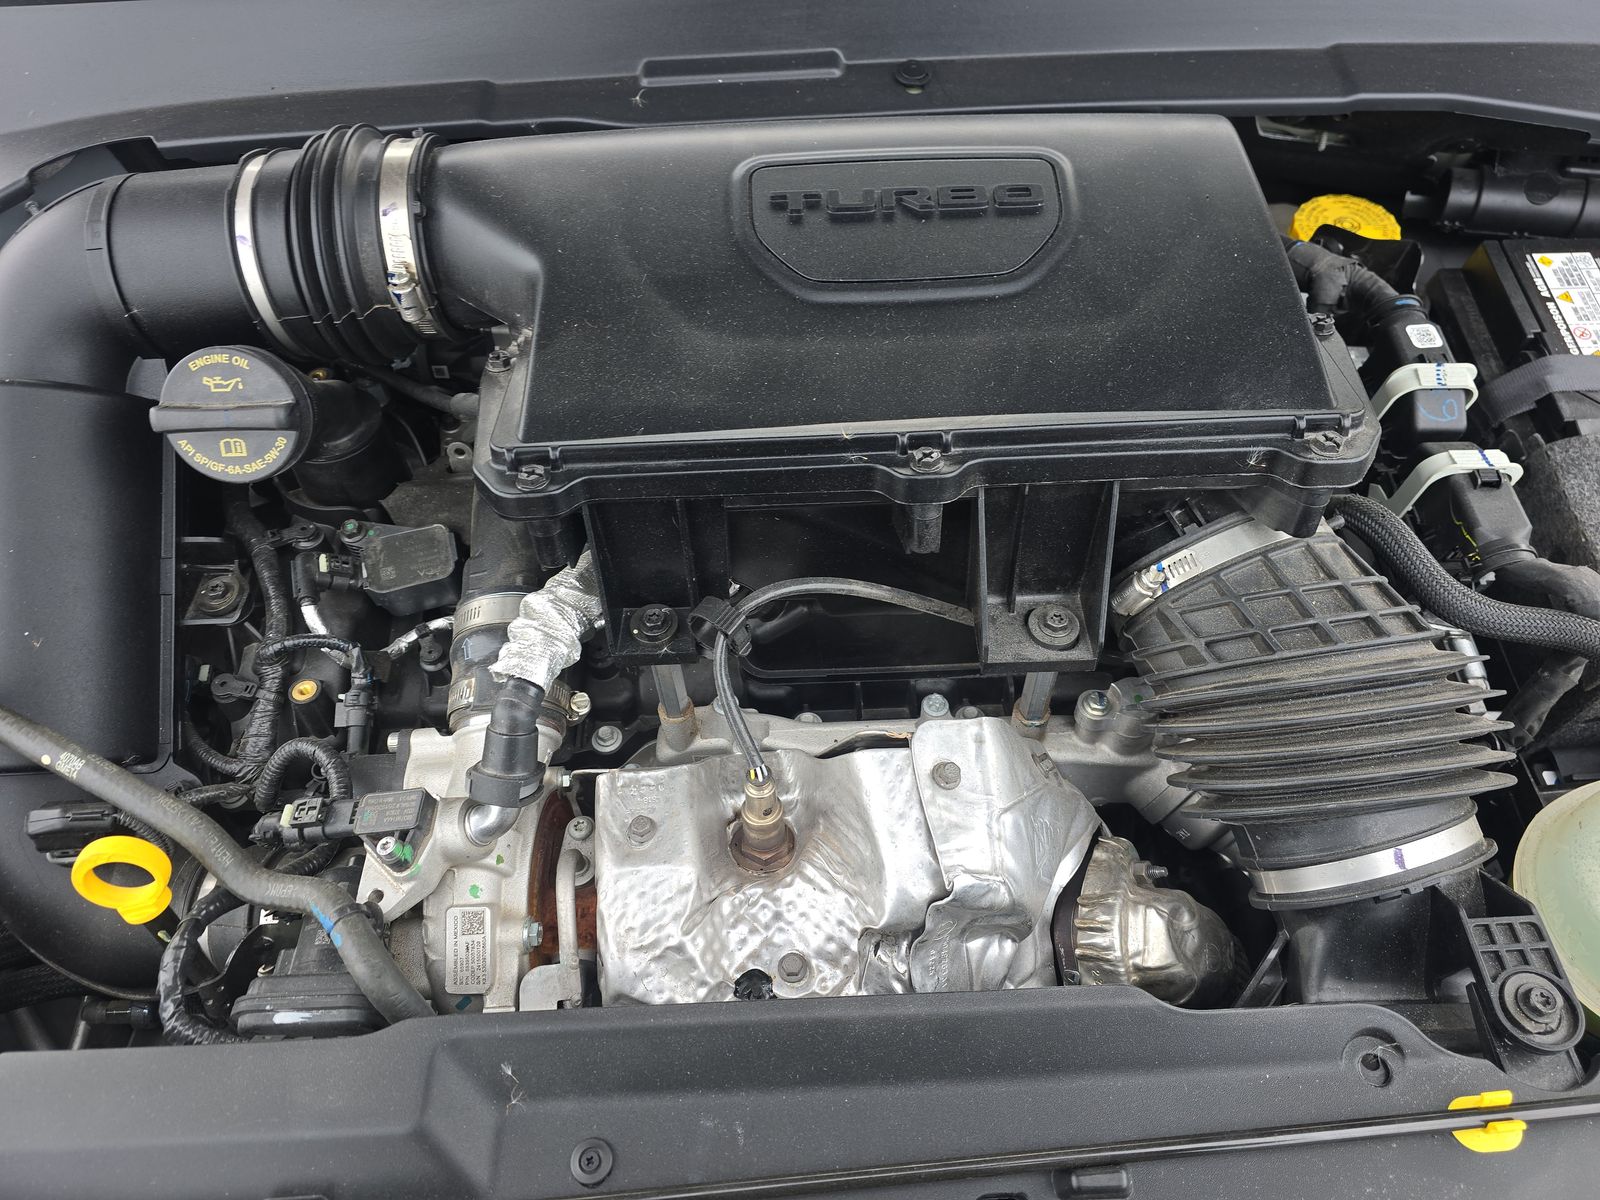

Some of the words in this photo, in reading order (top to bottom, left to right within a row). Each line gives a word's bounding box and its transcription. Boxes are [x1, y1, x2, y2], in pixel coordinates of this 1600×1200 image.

[769, 183, 1045, 222] TURBO
[188, 354, 230, 372] ENGINE
[231, 355, 251, 370] OIL
[177, 439, 196, 456] API
